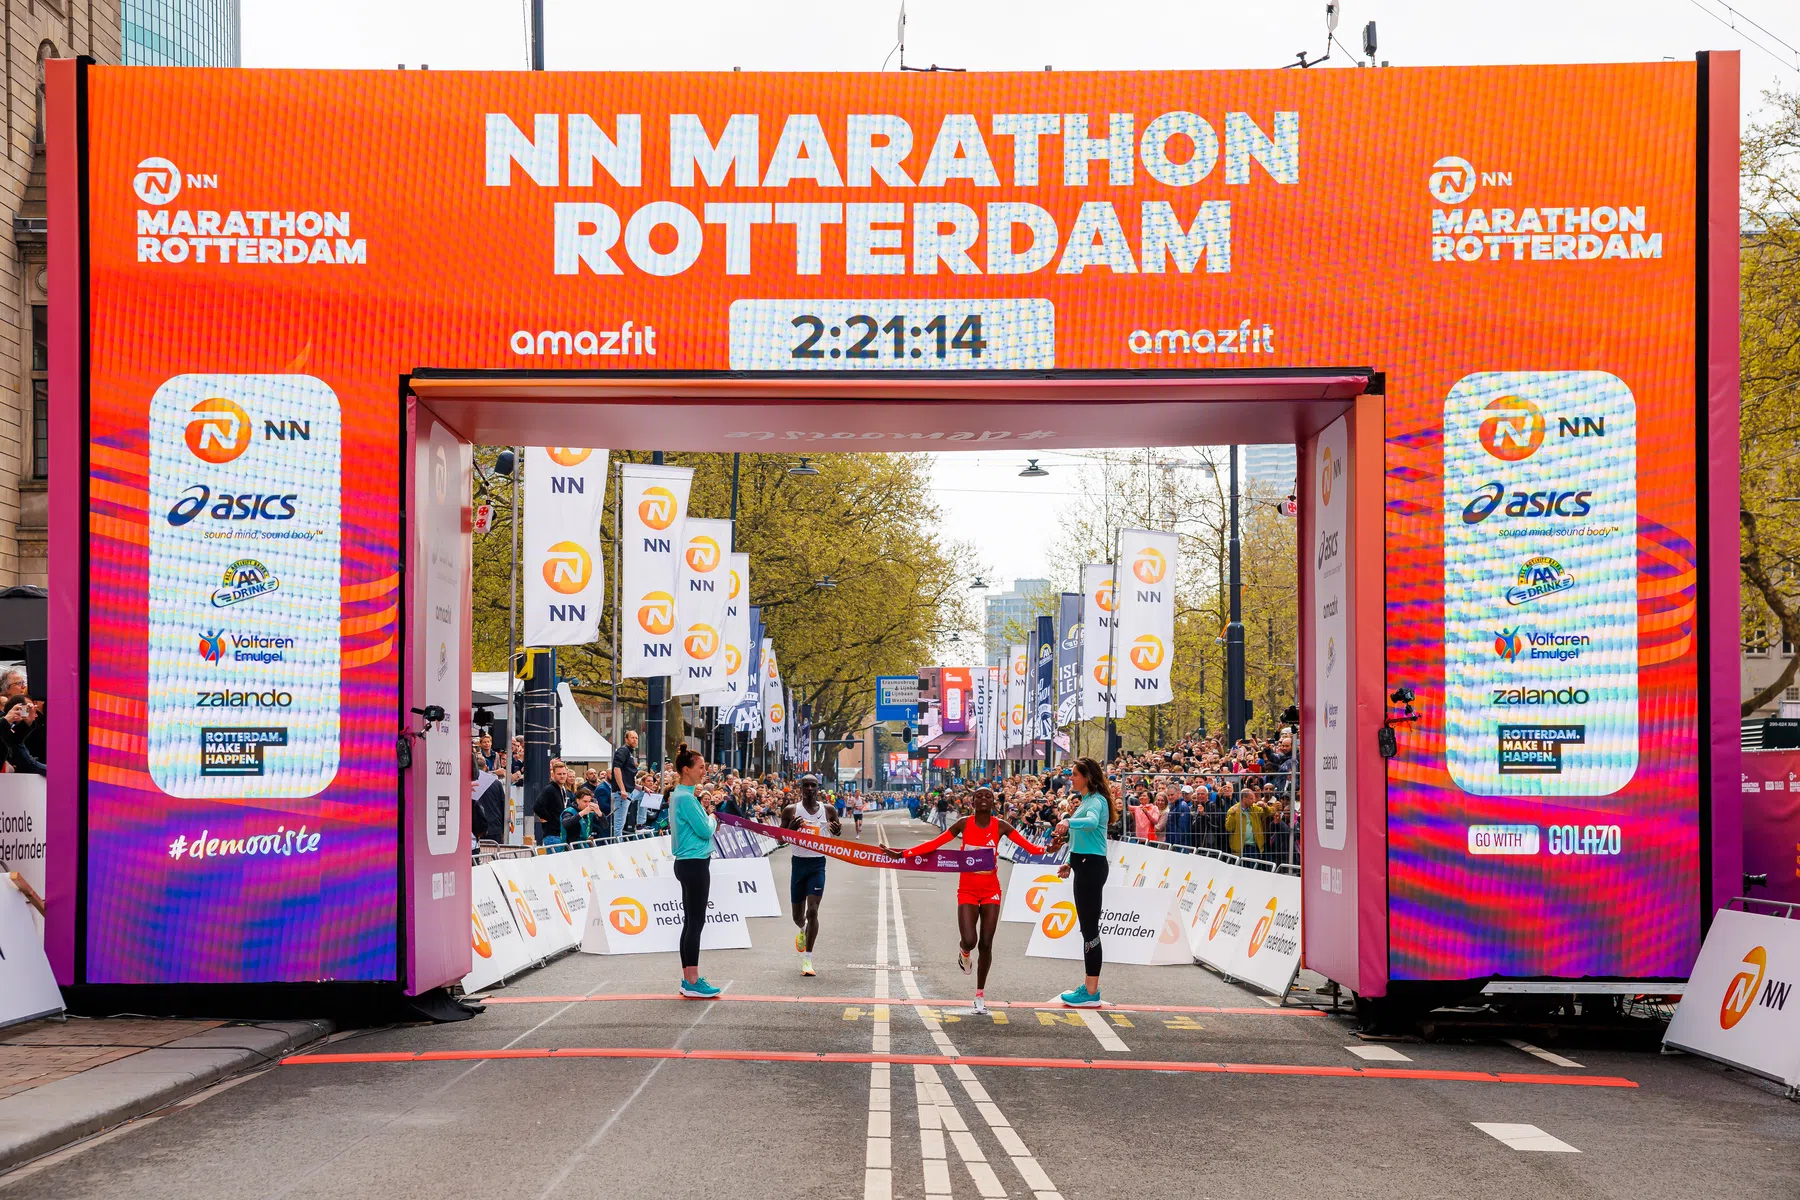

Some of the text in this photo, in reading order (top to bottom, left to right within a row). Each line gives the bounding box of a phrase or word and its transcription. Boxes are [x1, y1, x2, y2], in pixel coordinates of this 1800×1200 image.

[485, 111, 1299, 188] NN MARATHON
[186, 173, 218, 189] NN
[1481, 171, 1513, 187] NN
[136, 209, 350, 237] MARATHON
[1432, 206, 1646, 235] MARATHON
[553, 200, 1232, 277] ROTTERDAM
[1432, 232, 1663, 262] ROTTERDAM
[136, 236, 367, 265] ROTTERDAM
[510, 320, 657, 356] amazfit
[790, 314, 987, 360] 2:21:14
[1127, 318, 1275, 355] amazfit
[264, 420, 310, 441] NN
[1557, 416, 1605, 438] NN
[551, 476, 585, 494] NN
[210, 494, 298, 520] asics
[1504, 491, 1593, 518] asics
[203, 530, 232, 539] sound
[261, 530, 290, 539] sound
[1498, 528, 1527, 537] sound
[1556, 527, 1584, 536] sound
[643, 538, 671, 553] NN
[236, 569, 262, 589] AA
[690, 579, 714, 592] NN
[1532, 567, 1557, 587] AA
[232, 582, 267, 600] DRINK
[1137, 590, 1161, 603] NN
[1527, 579, 1562, 598] DRINK
[549, 604, 586, 622] NN
[231, 635, 294, 649] Voltaren
[1527, 632, 1590, 646] Voltaren
[235, 650, 283, 664] Emulgel
[643, 643, 672, 658] NN
[1531, 647, 1580, 662] Emulgel
[688, 666, 712, 679] NN
[1134, 677, 1158, 690] NN
[196, 689, 293, 707] zalando
[1493, 686, 1589, 705] zalando
[205, 731, 283, 742] ROTTERDAM.
[1503, 729, 1581, 740] ROTTERDAM.
[205, 743, 257, 754] MAKE IT
[1503, 740, 1554, 751] MAKE IT
[205, 754, 259, 765] HAPPEN.
[1503, 751, 1557, 762] HAPPEN.
[168, 824, 321, 860] #demooiste
[799, 838, 851, 857] MARATHON
[1475, 832, 1522, 847] GO WITH
[1548, 824, 1621, 855] GOLAZO
[1759, 979, 1793, 1011] NN
